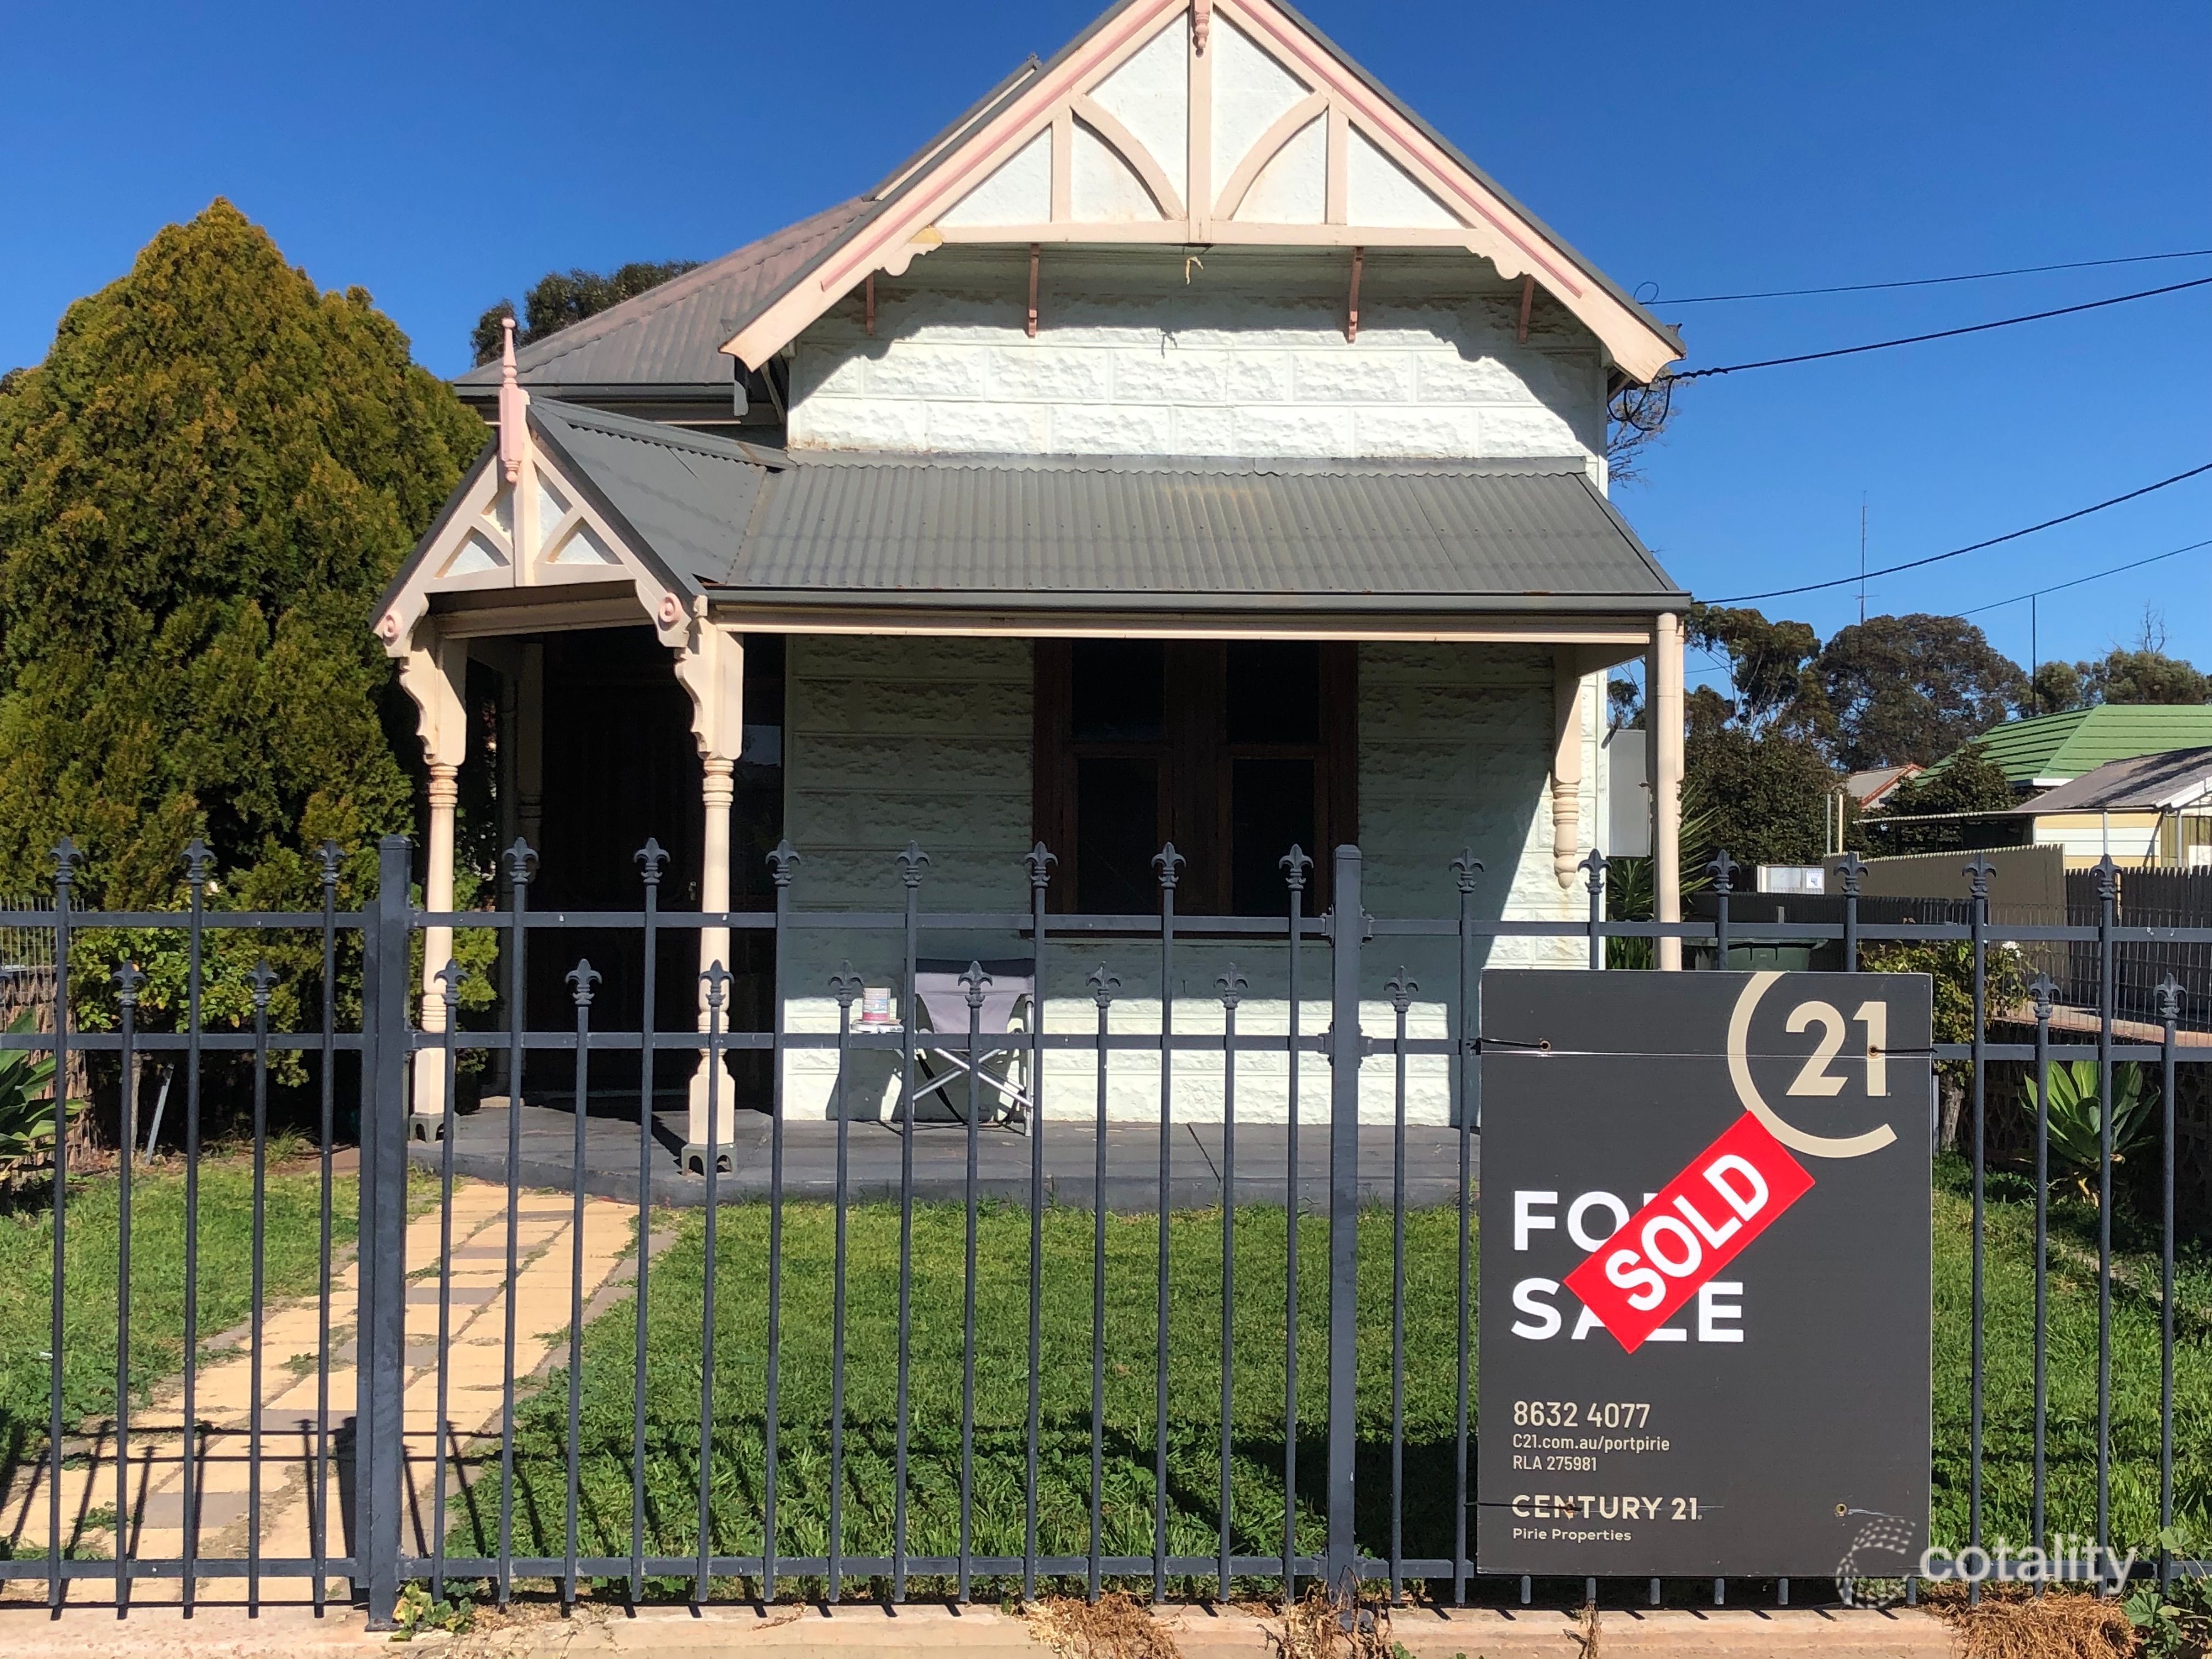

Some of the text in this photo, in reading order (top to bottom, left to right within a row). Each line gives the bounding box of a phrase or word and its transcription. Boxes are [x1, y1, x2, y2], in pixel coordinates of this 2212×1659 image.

[1514, 1190, 1658, 1253] FO
[1605, 1154, 1769, 1311] SOLD
[1513, 1401, 1651, 1429] 8632 4077
[1513, 1433, 1670, 1454] C21.com.au/portpirie
[1513, 1455, 1597, 1471] RLA 275981
[1511, 1494, 1697, 1520] CENTURY 21
[1513, 1527, 1632, 1544] Pirie Properties
